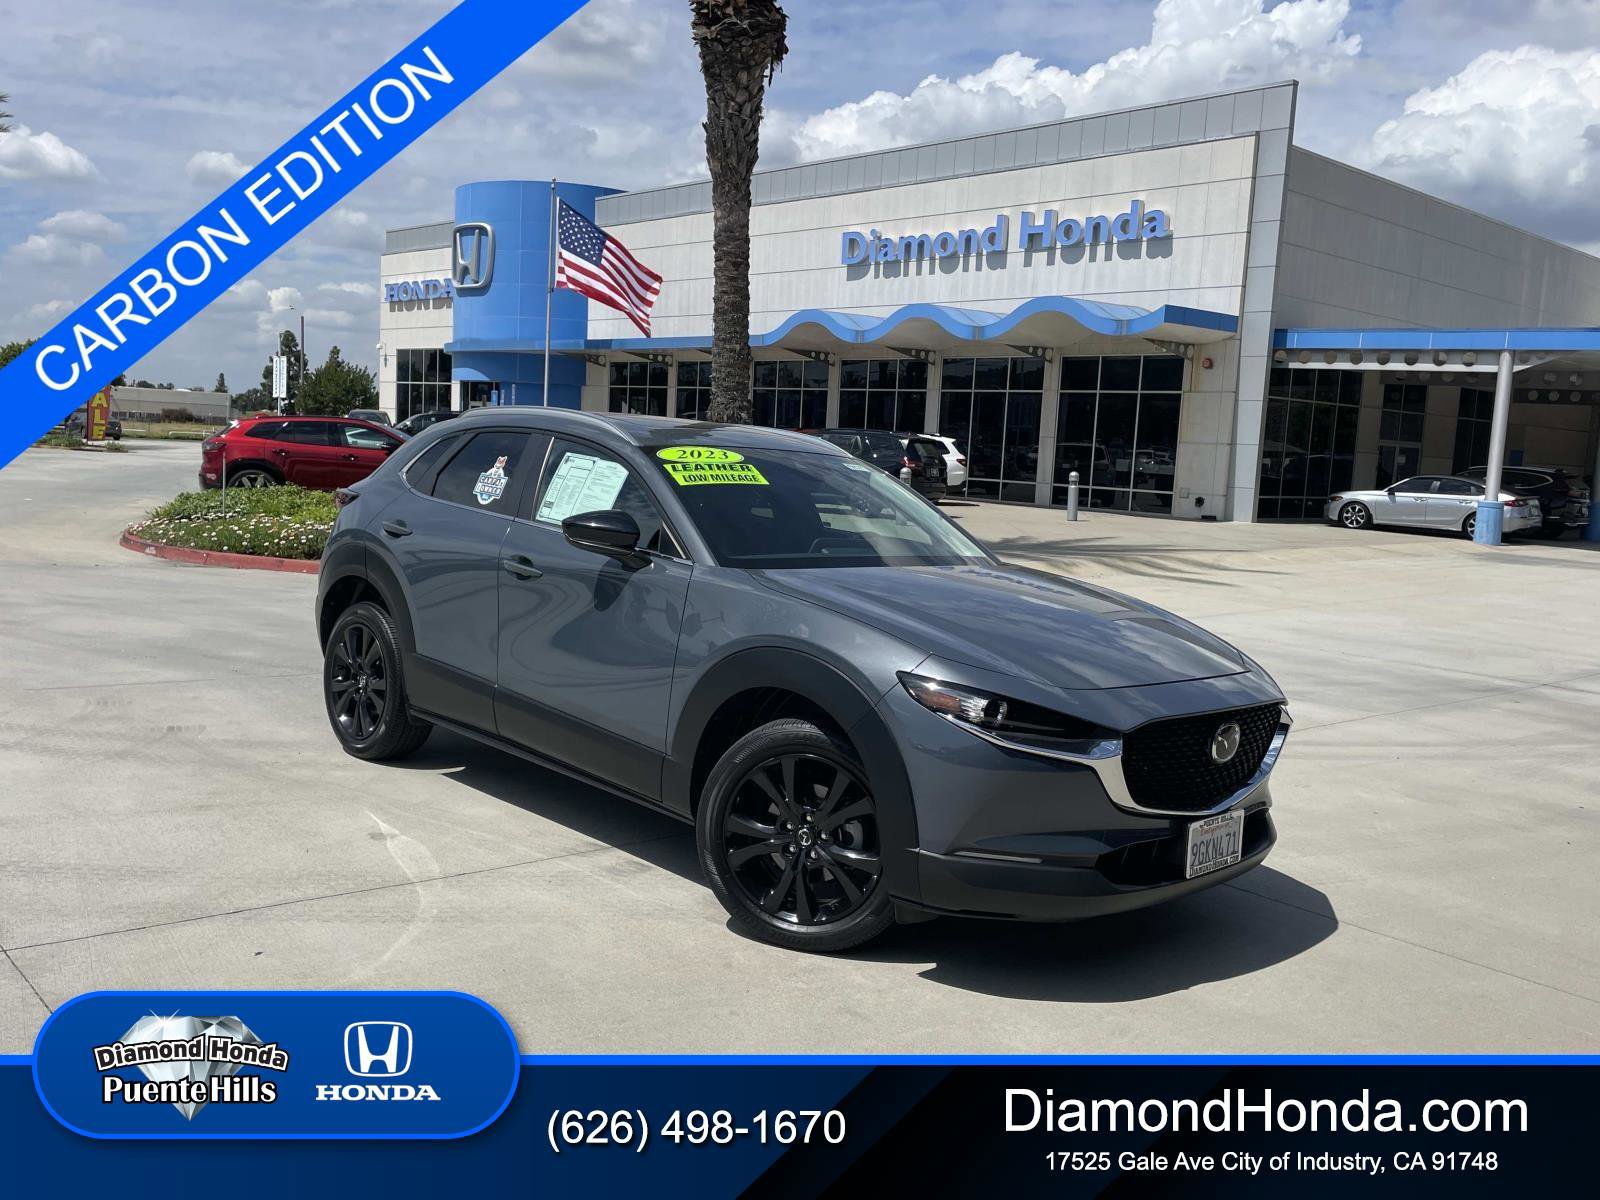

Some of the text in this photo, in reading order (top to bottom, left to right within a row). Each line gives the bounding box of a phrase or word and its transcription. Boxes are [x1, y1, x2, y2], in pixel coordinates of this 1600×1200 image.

[842, 200, 1172, 266] Diamond Honda
[384, 278, 455, 302] HONDA
[676, 449, 729, 460] 2023
[670, 463, 752, 472] LEATHER
[682, 473, 760, 482] LOW MILEAGE
[1190, 831, 1238, 867] 9GKN471
